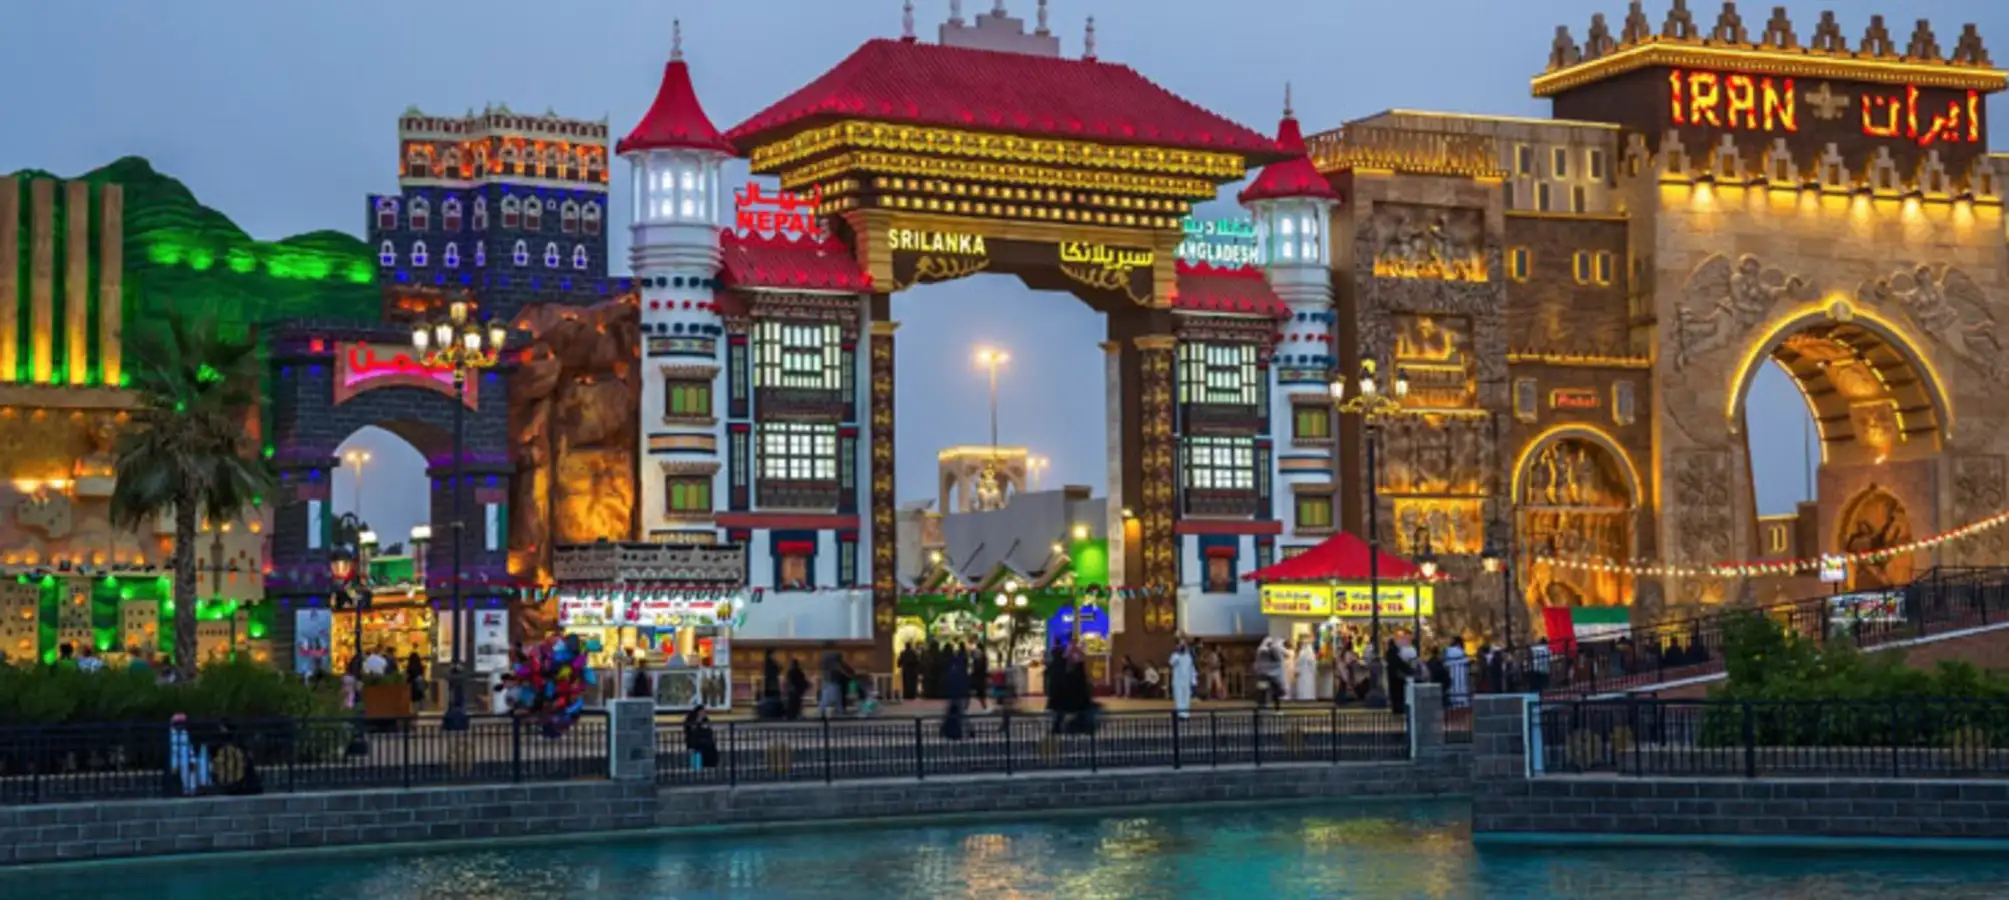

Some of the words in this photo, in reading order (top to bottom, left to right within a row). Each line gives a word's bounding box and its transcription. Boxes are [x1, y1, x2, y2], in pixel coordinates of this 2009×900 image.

[1670, 69, 1797, 131] IRAN
[1862, 84, 1979, 146] ايران
[736, 211, 825, 235] NEPAL
[888, 228, 986, 256] SRILANKA
[1060, 240, 1156, 272] سيريلانكا
[1174, 240, 1259, 263] ANGLADESH
